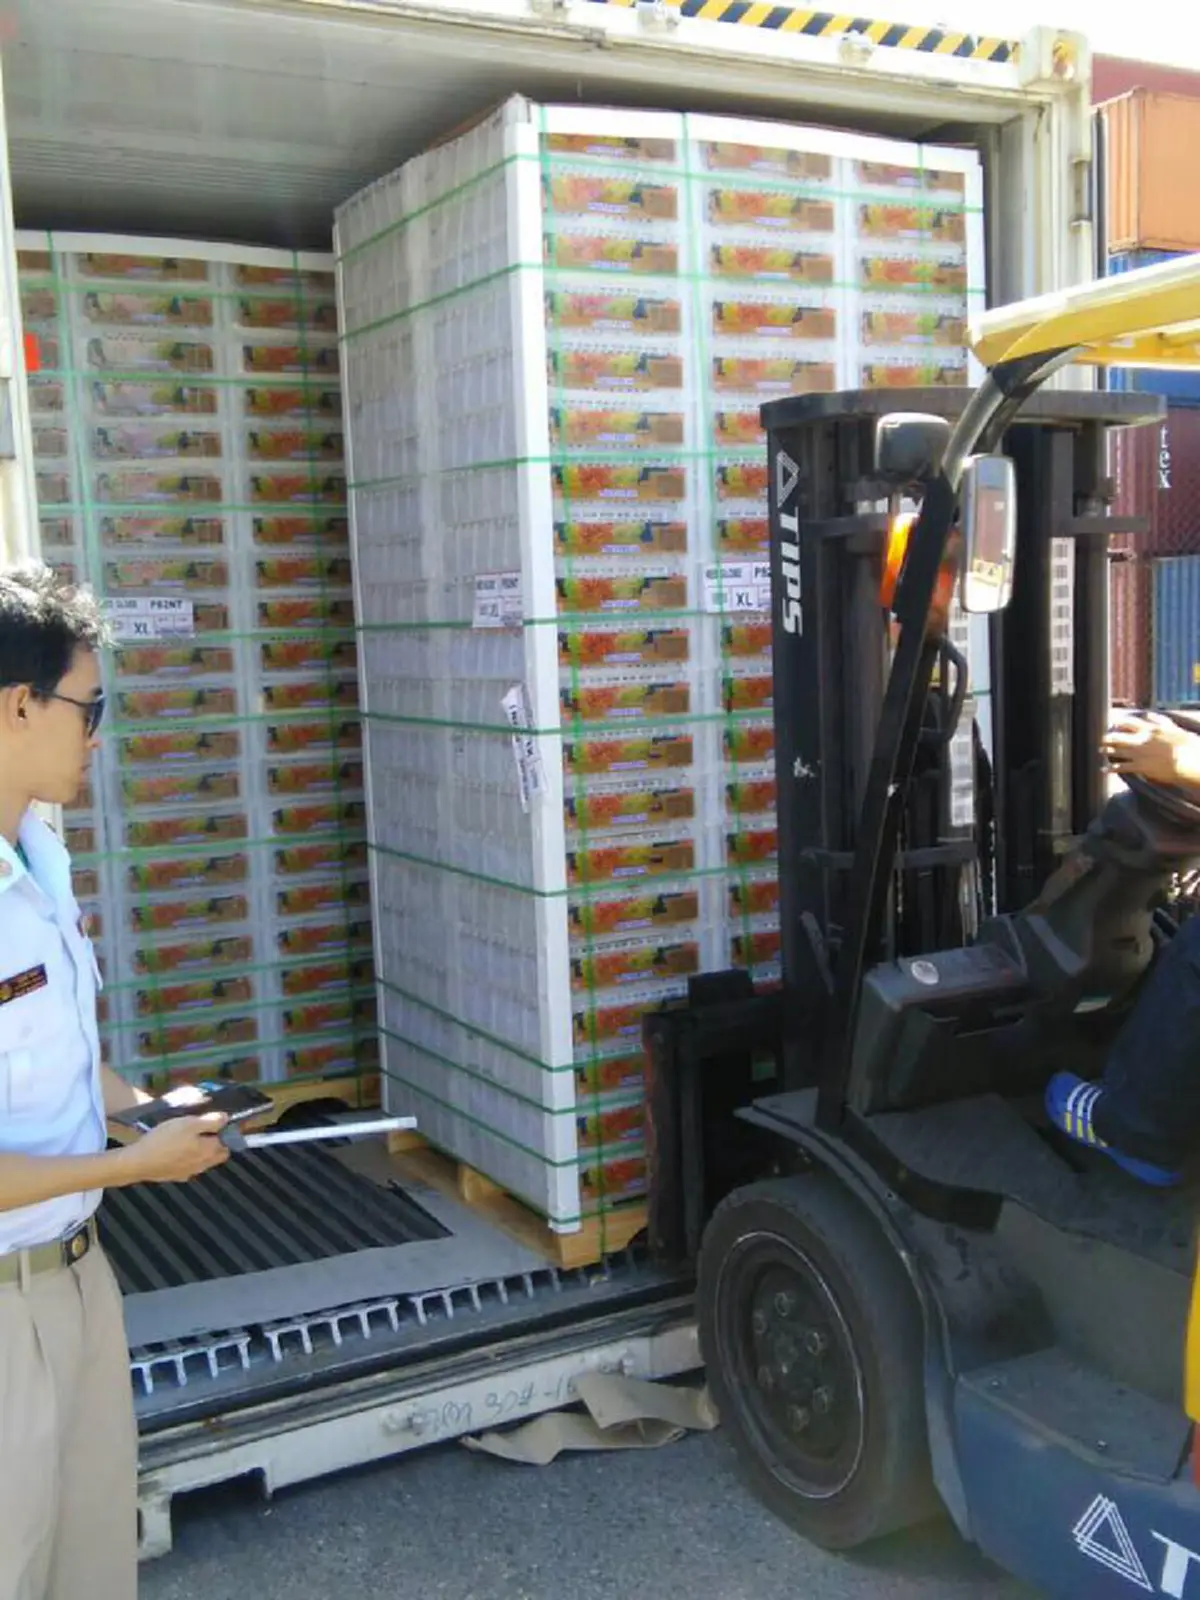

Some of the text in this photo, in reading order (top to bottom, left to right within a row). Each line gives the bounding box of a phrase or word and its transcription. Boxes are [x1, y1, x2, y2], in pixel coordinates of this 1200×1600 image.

[779, 506, 803, 637] TIPS
[736, 592, 753, 607] XL
[133, 622, 148, 635] XL
